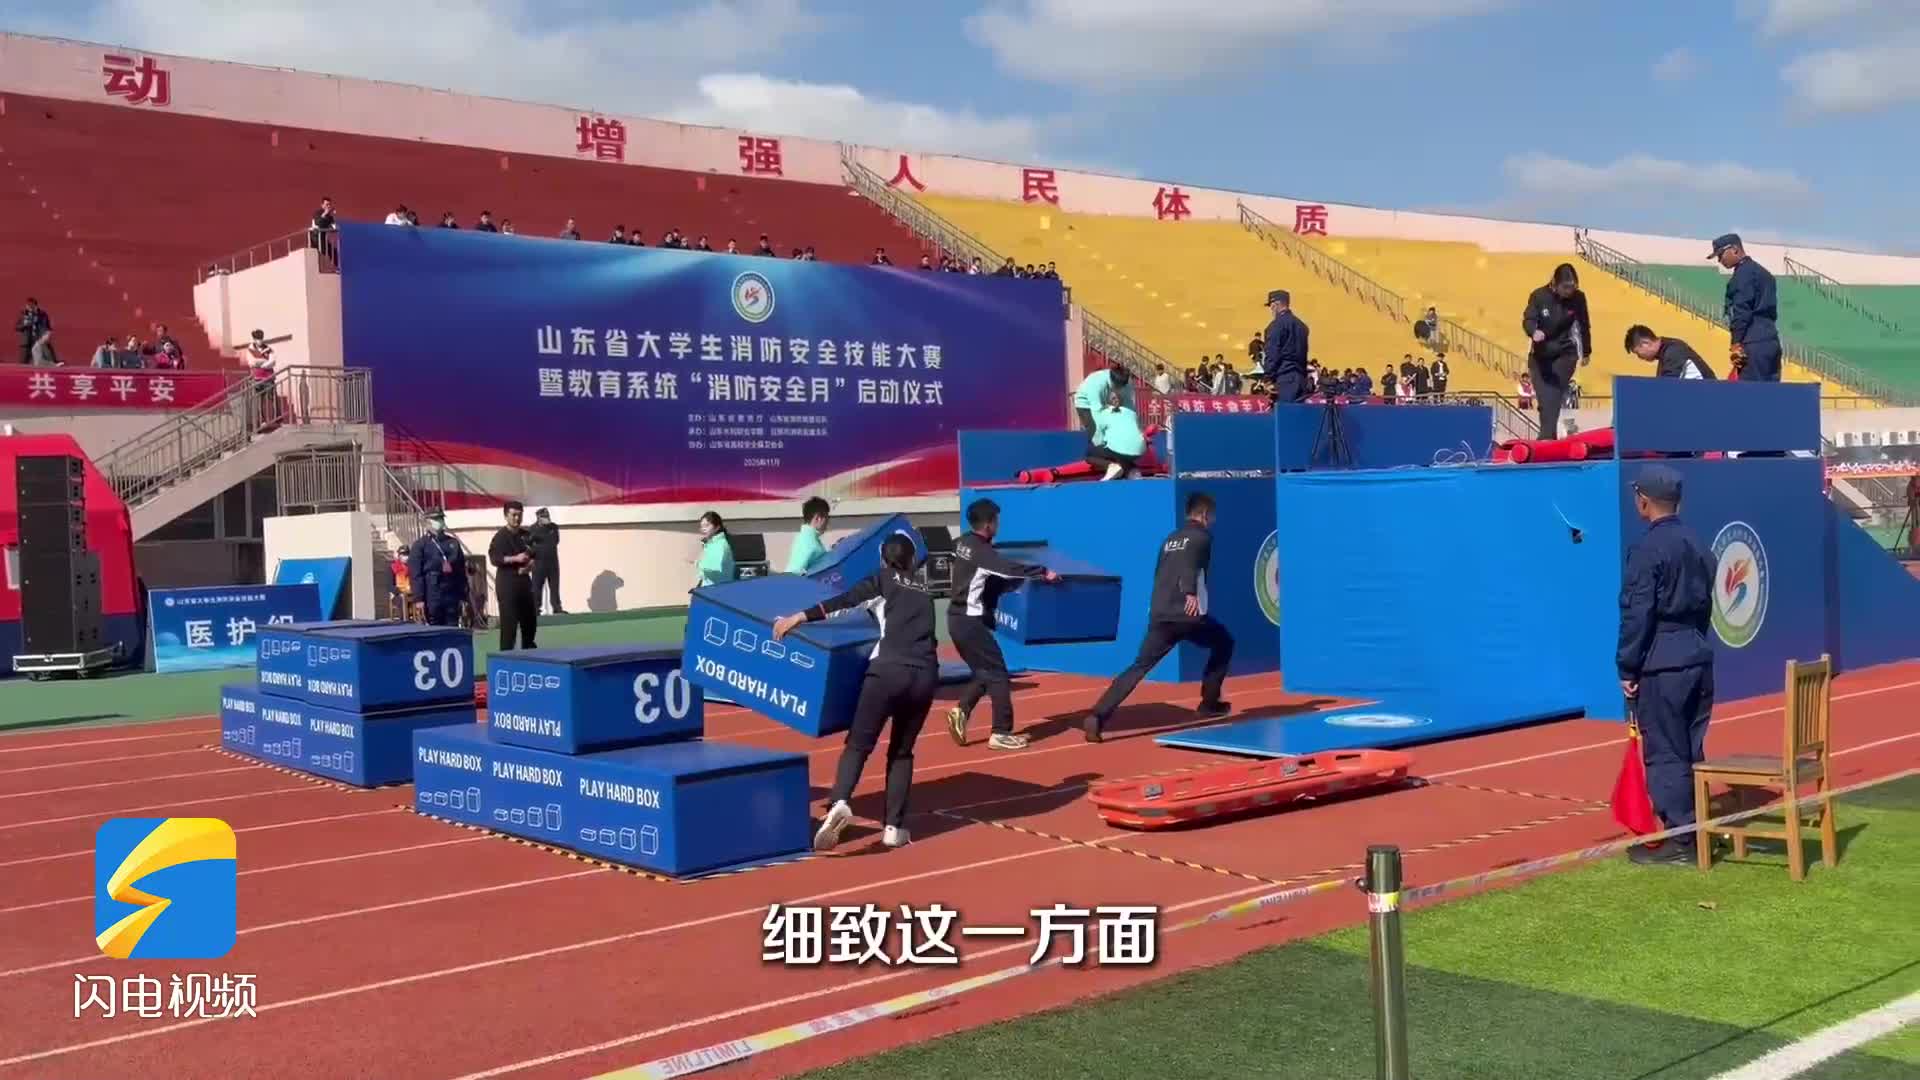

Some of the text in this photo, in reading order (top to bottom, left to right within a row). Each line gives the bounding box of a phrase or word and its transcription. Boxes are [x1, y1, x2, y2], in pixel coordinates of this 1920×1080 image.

[103, 54, 171, 107] 动
[537, 325, 942, 369] 山东省大学生消防安全技能大赛
[29, 373, 175, 402] 共享平安
[413, 647, 464, 691] 03
[695, 654, 808, 717] PLAY HARD BOX
[262, 708, 275, 721] PLAY
[310, 719, 355, 738] PLAY HARD BOX
[494, 711, 561, 737] PLAY HARD BOX
[418, 746, 482, 772] PLAY HARD BOX
[493, 761, 563, 787] PLAY HARD BOX
[580, 777, 660, 809] PLAY HARD BOX
